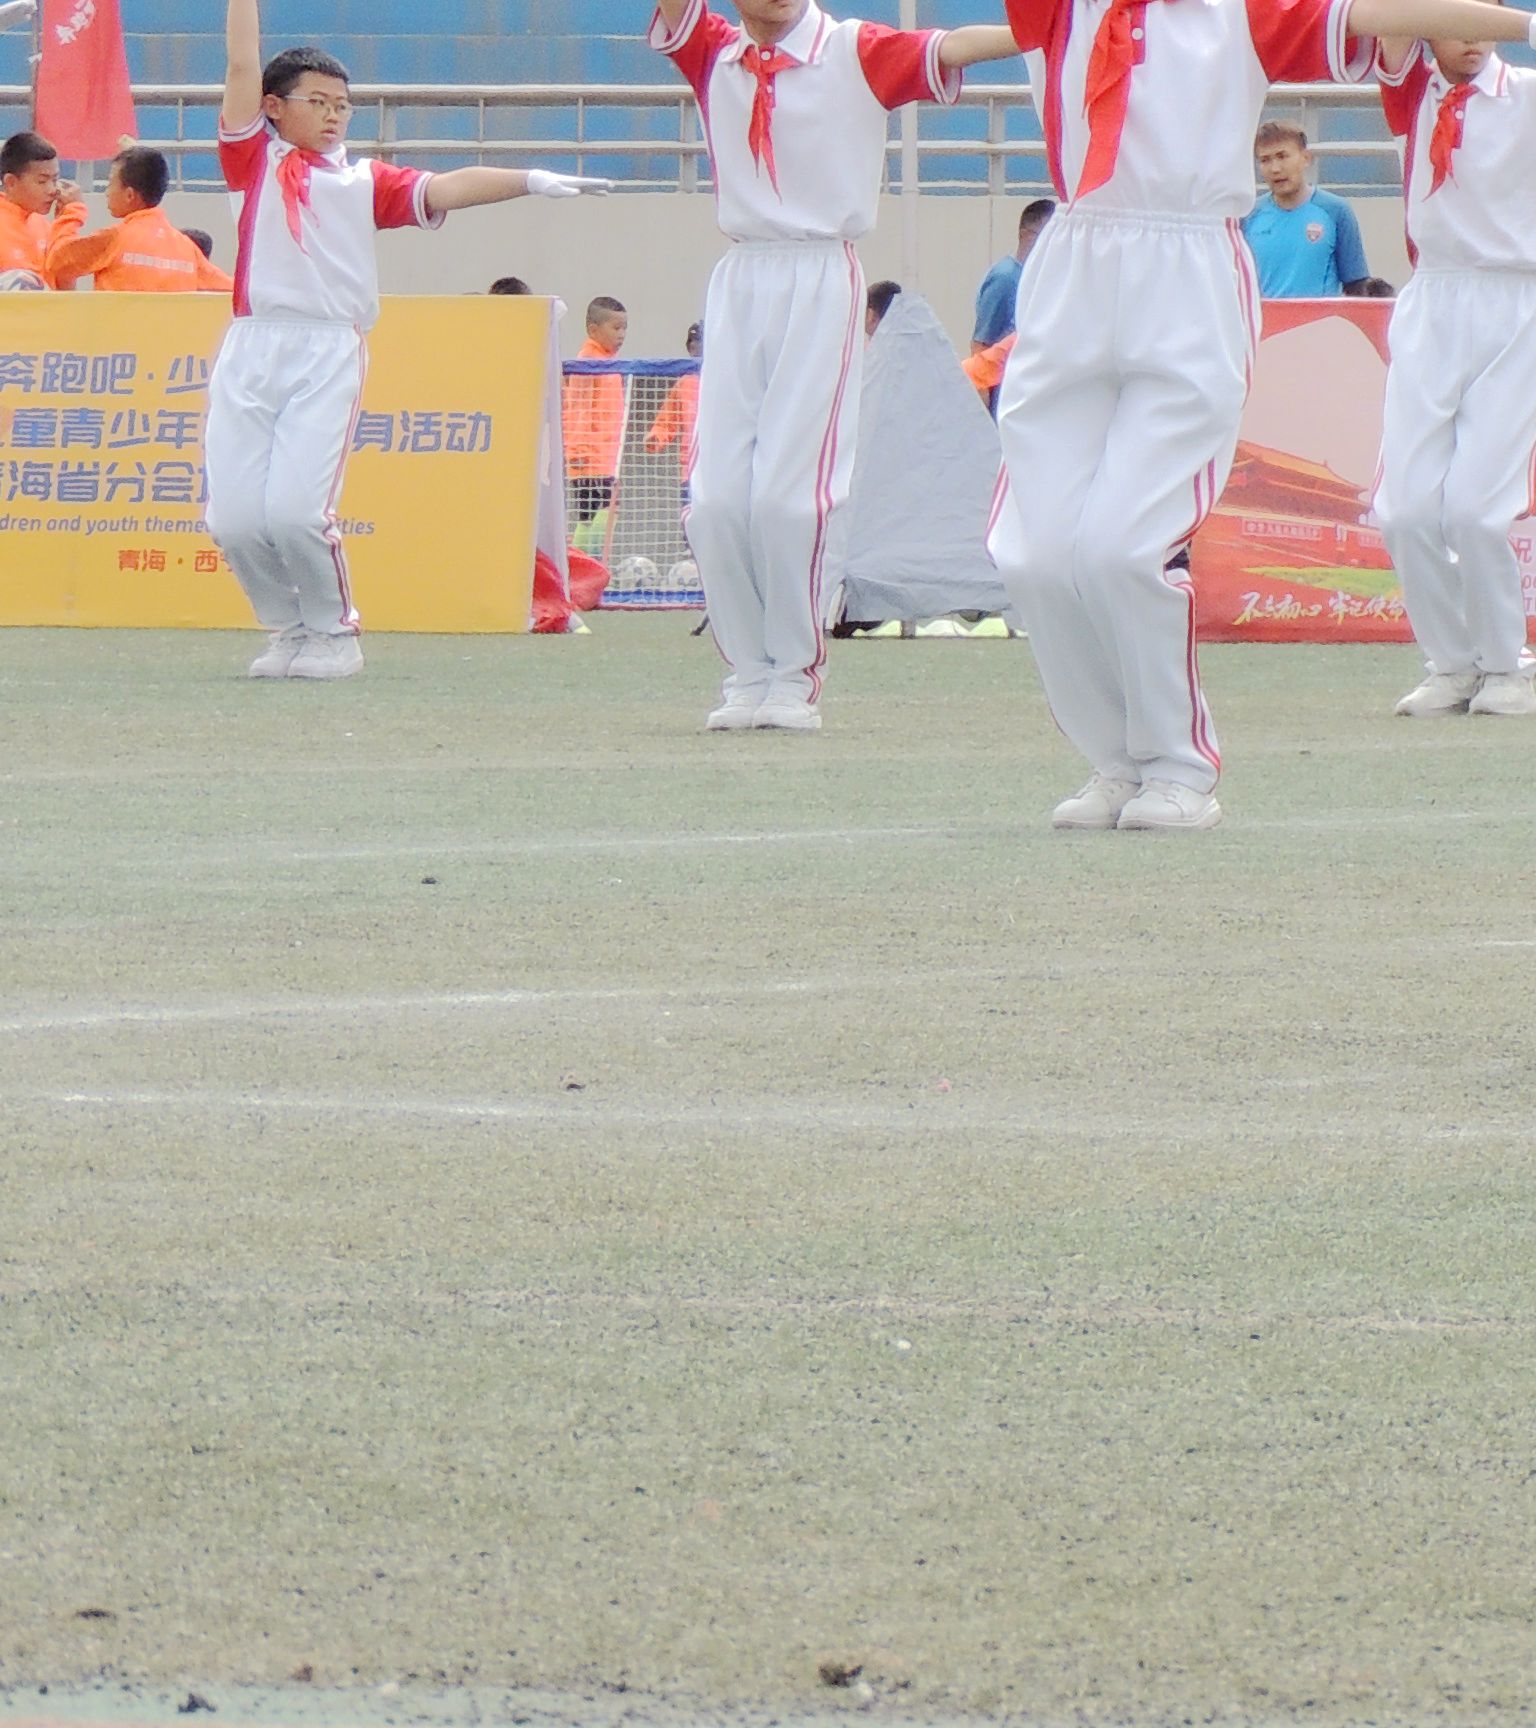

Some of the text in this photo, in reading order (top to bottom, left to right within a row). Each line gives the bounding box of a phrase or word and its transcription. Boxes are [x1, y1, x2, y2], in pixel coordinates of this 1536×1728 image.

[0, 461, 208, 503] 海省分会
[46, 514, 81, 532] and
[86, 515, 139, 536] youth
